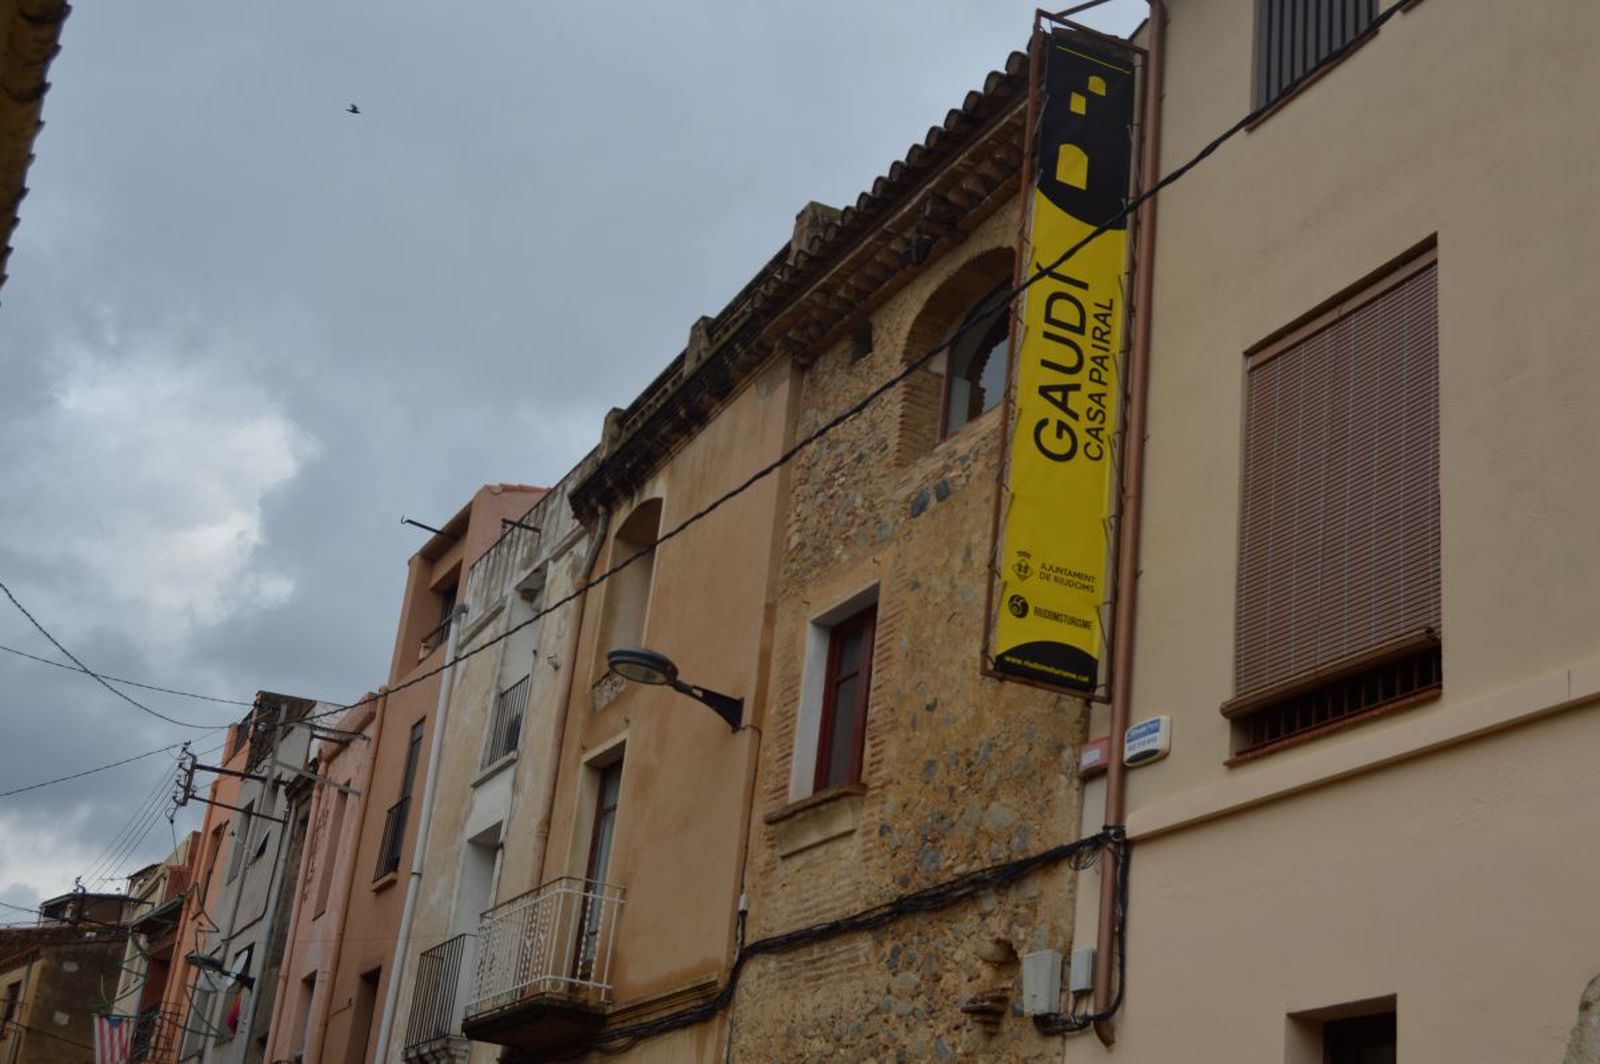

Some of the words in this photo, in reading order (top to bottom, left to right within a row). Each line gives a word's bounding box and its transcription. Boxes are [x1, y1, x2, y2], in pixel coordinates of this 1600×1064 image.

[1089, 298, 1113, 386] PAIRAL
[1084, 393, 1107, 461] CASA
[1039, 571, 1050, 582] DE
[1053, 576, 1095, 593] RIUDOMS
[1040, 563, 1096, 583] AJUNTAMENT
